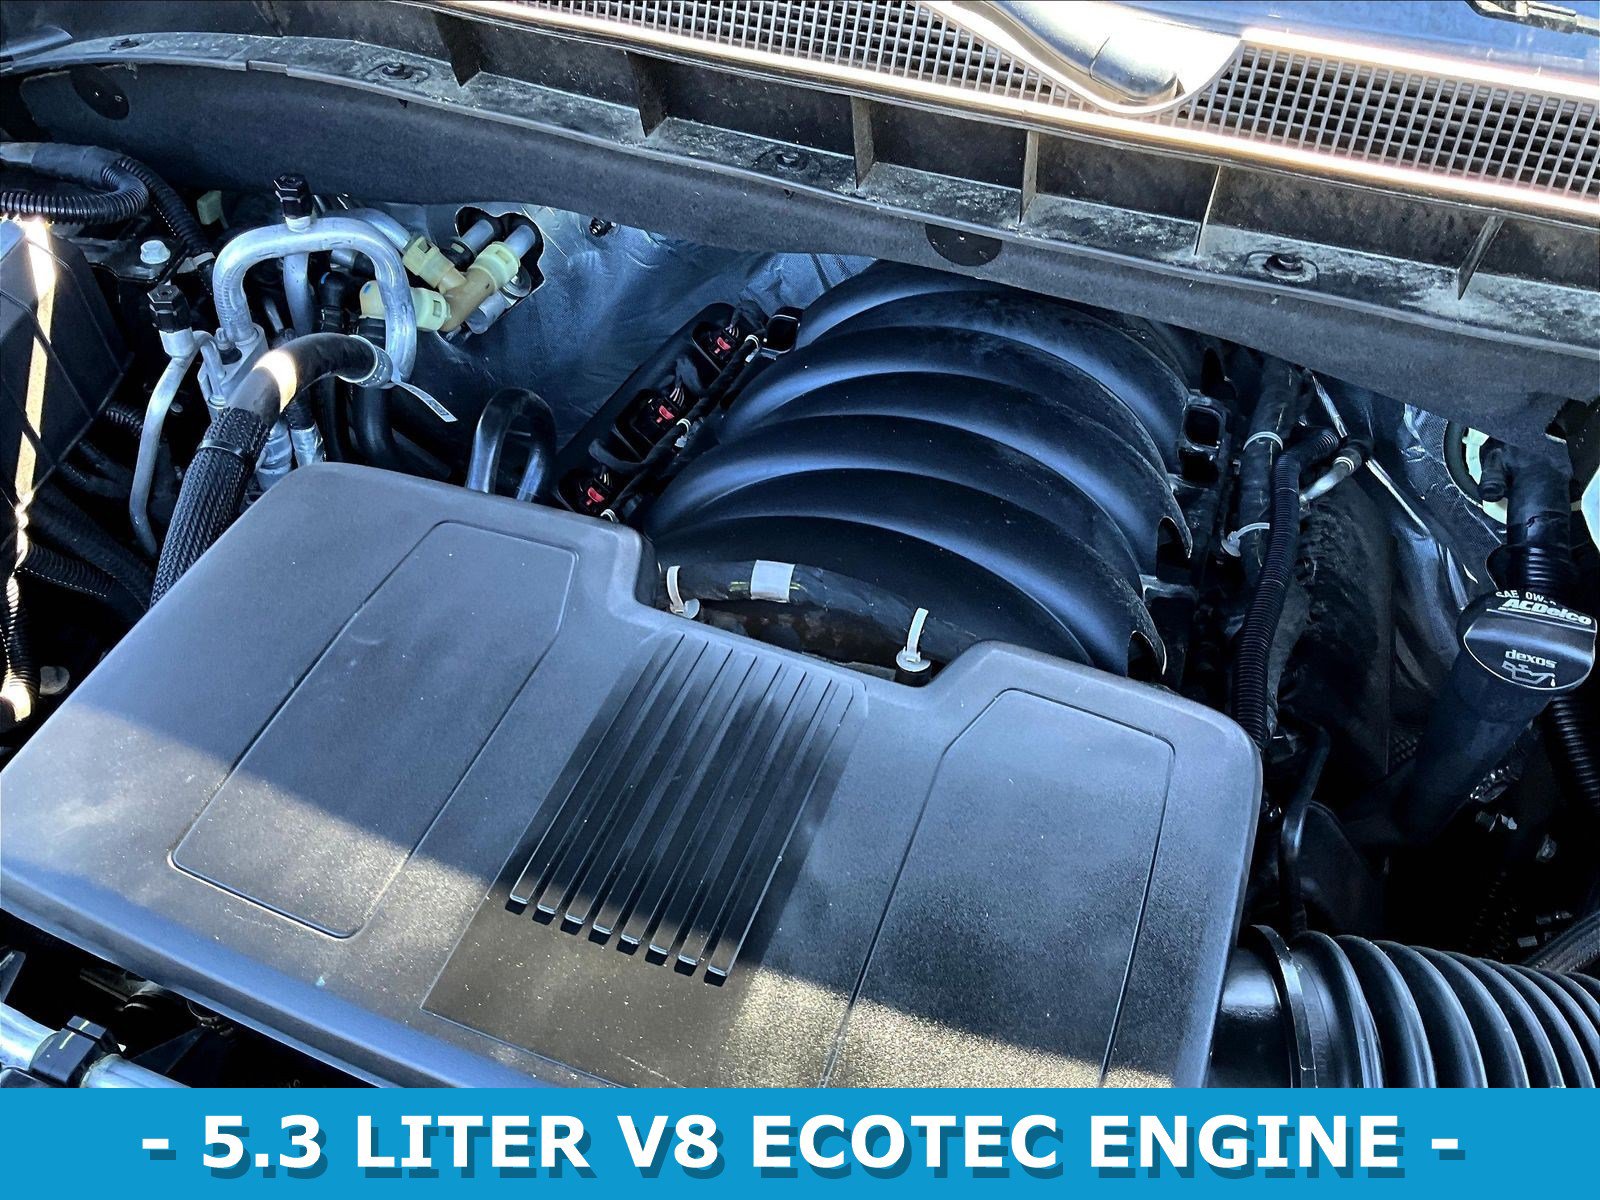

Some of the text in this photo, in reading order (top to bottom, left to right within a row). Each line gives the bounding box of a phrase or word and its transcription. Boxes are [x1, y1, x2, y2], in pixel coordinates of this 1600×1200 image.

[1495, 589, 1520, 599] SAE
[1501, 598, 1592, 625] ACDelco
[1505, 649, 1558, 669] dexos
